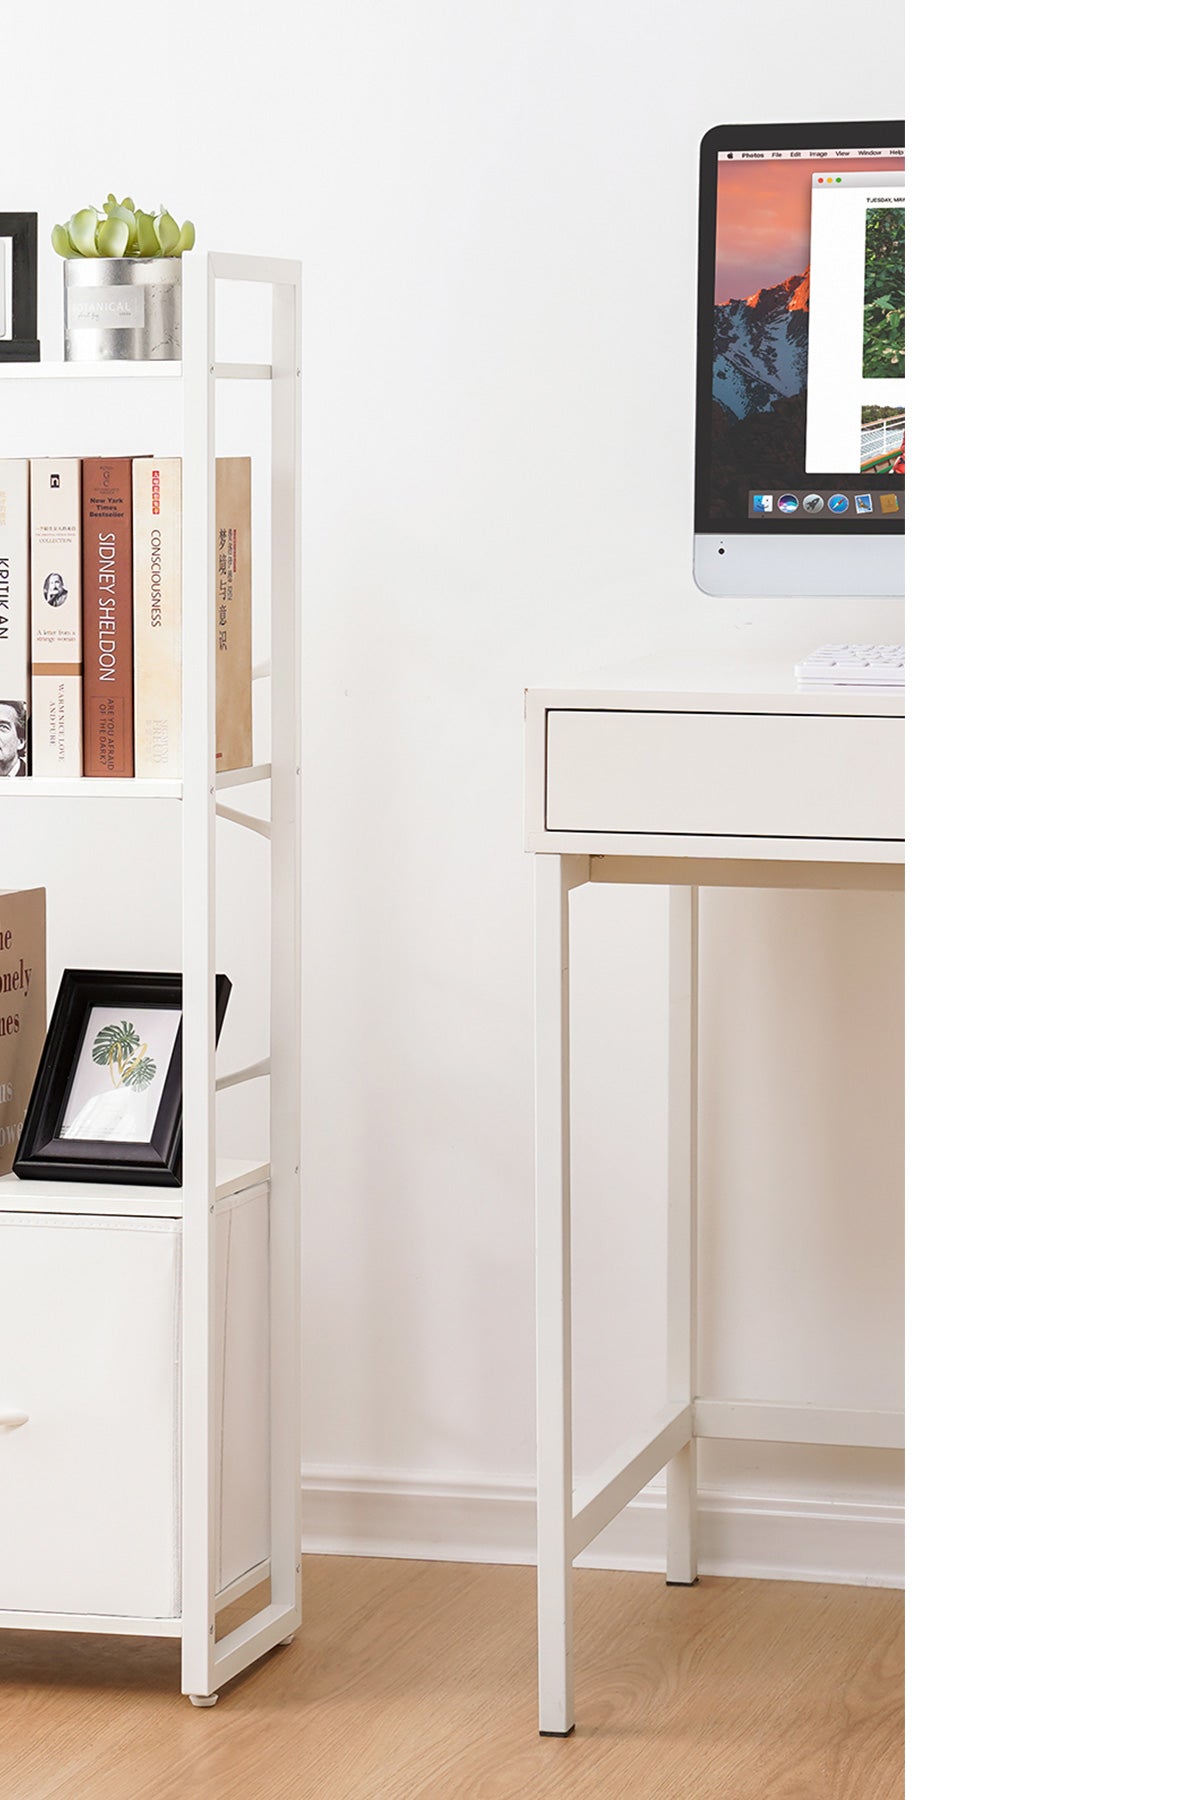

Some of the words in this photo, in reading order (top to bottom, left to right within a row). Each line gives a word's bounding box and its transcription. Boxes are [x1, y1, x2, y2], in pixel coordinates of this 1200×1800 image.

[98, 532, 116, 595] SIDNEY
[150, 529, 162, 628] CONSCIOUSNESS
[98, 597, 116, 682] SHELDON
[99, 703, 106, 714] OF
[107, 698, 115, 715] ARE
[107, 717, 115, 736] YOU
[107, 738, 115, 771] AFRAID
